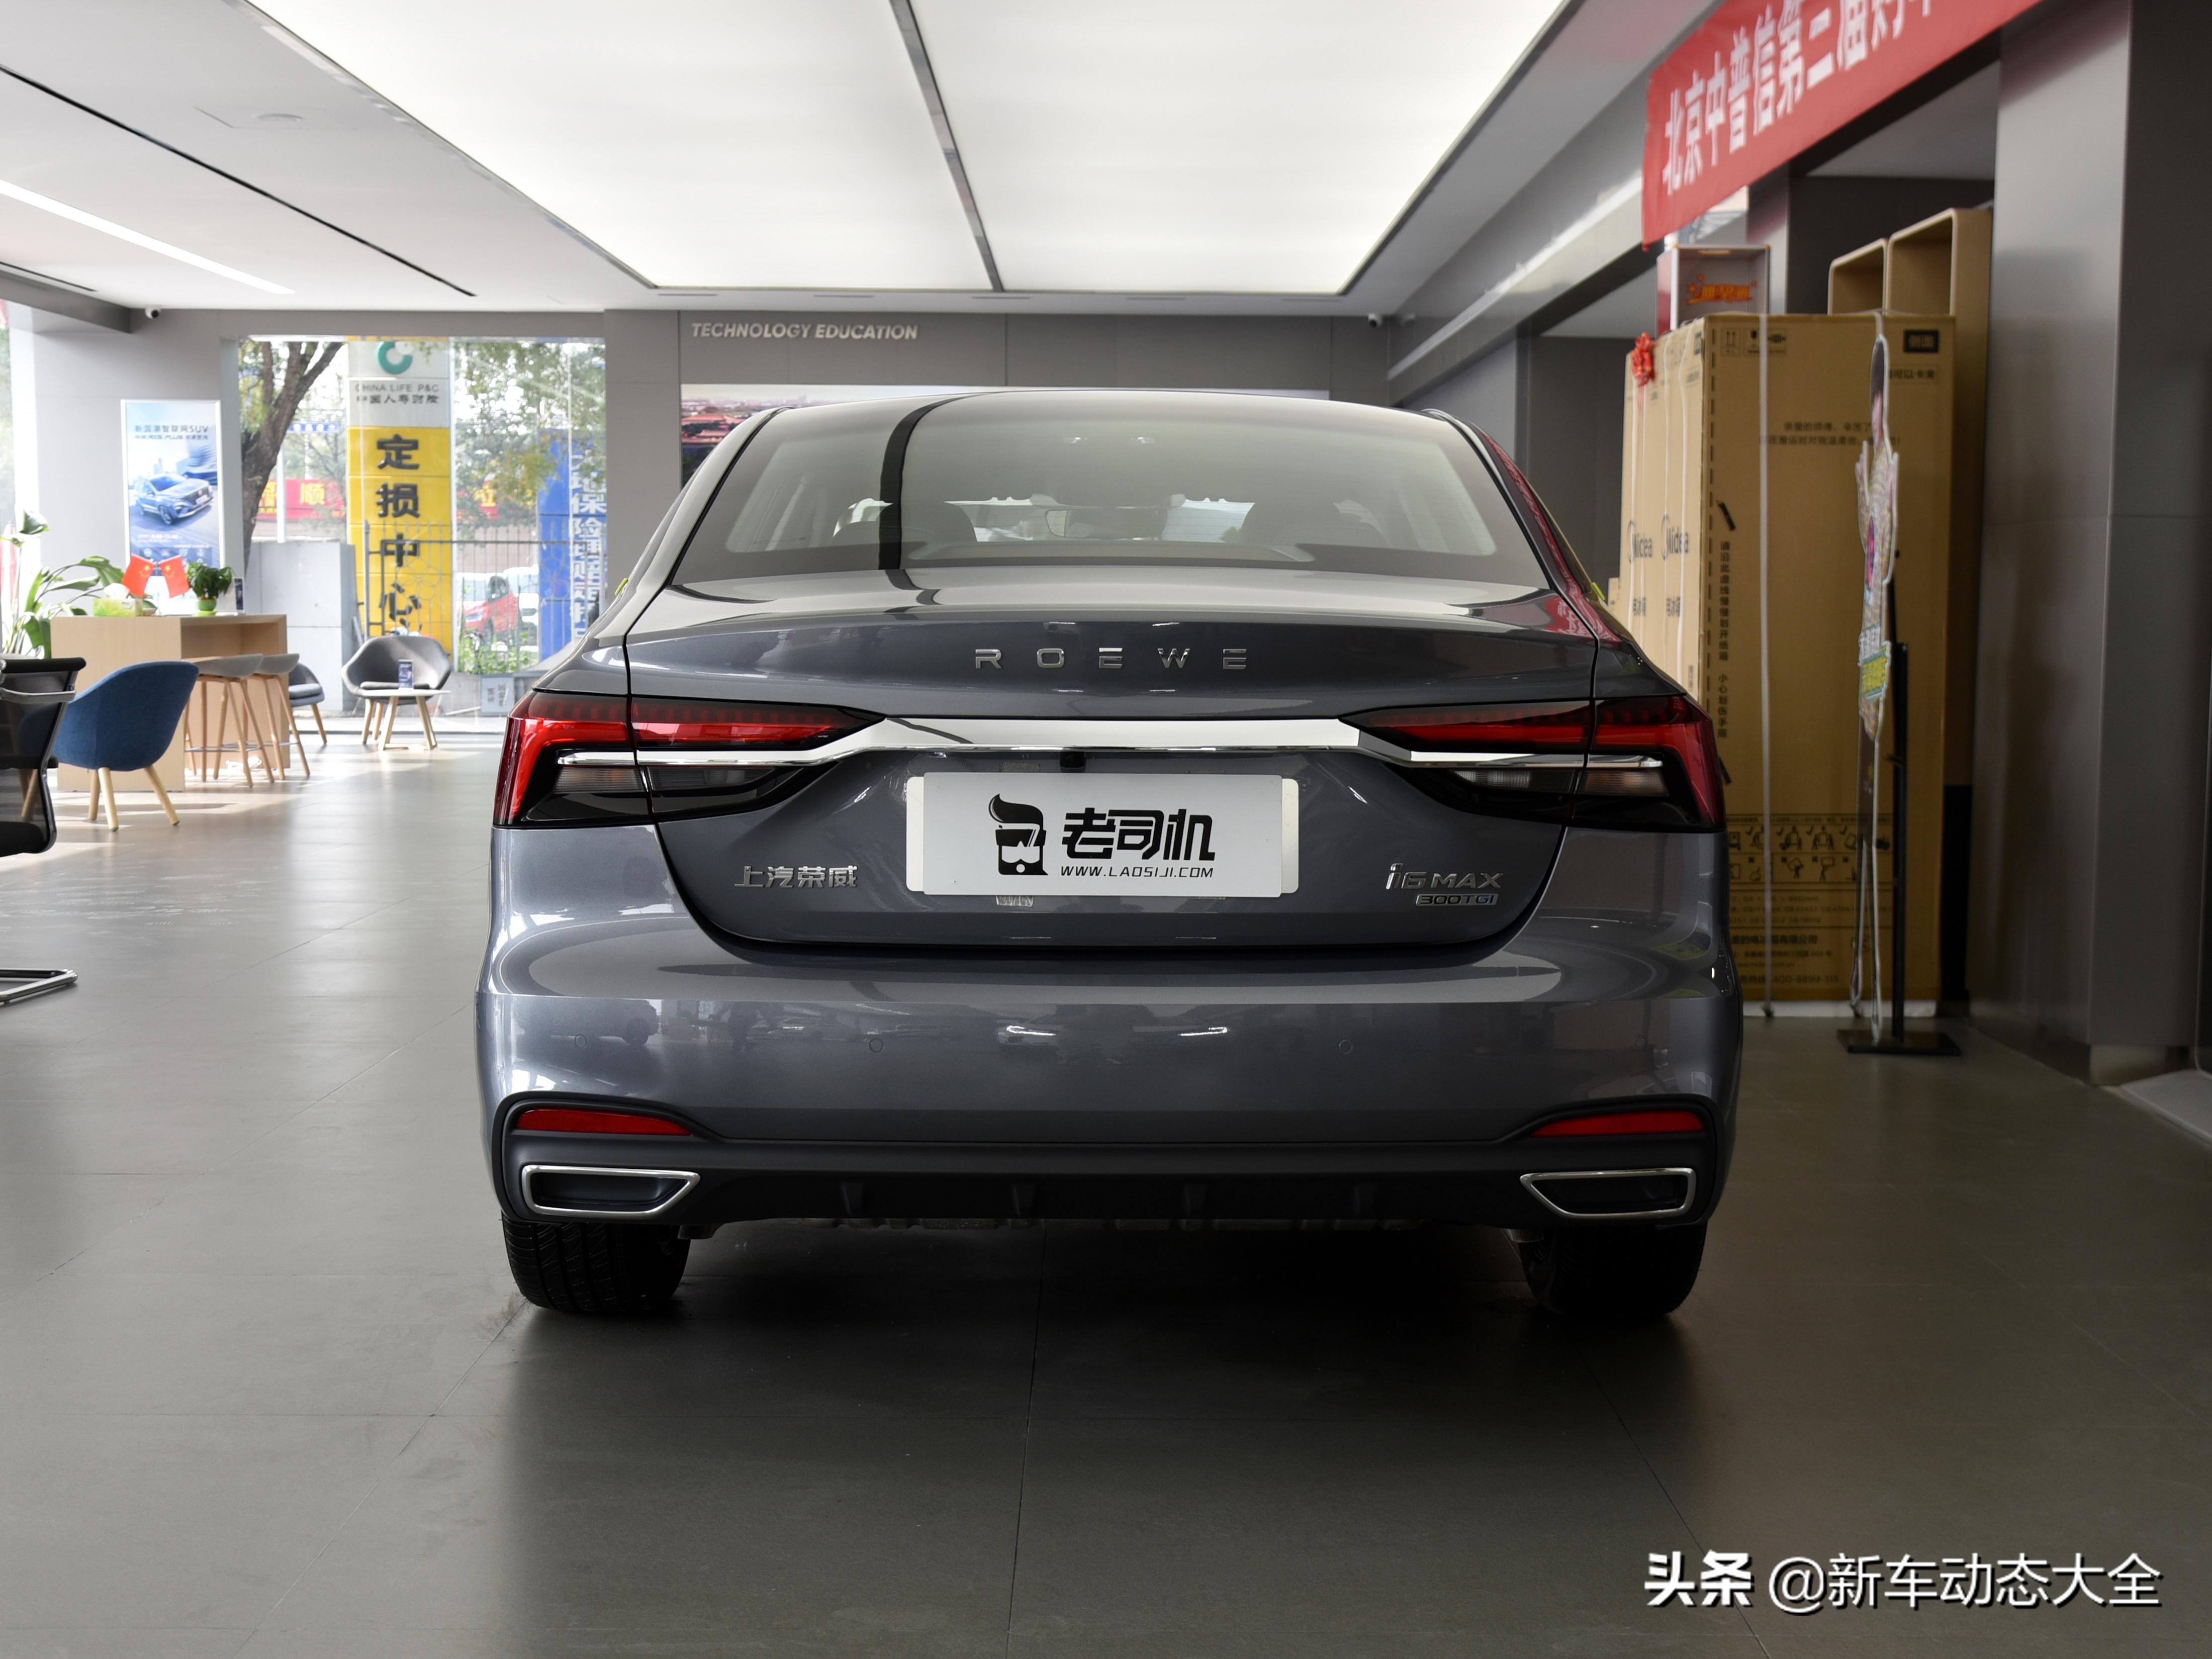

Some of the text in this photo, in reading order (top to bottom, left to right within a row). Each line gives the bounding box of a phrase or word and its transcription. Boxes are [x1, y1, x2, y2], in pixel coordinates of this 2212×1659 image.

[691, 322, 918, 340] TECHNOLOGY EDUCATION
[355, 384, 439, 392] CHINA LIFE P&C
[375, 434, 422, 633] 定损中心
[1666, 526, 1689, 554] Midea
[974, 648, 1247, 670] ROEWE
[1062, 807, 1215, 862] 老司机
[734, 864, 858, 889] 上汽荣威
[1061, 865, 1214, 879] WWW.LAOSIJI.COM
[1431, 873, 1504, 889] MAX
[1419, 894, 1496, 905] 300TGI
